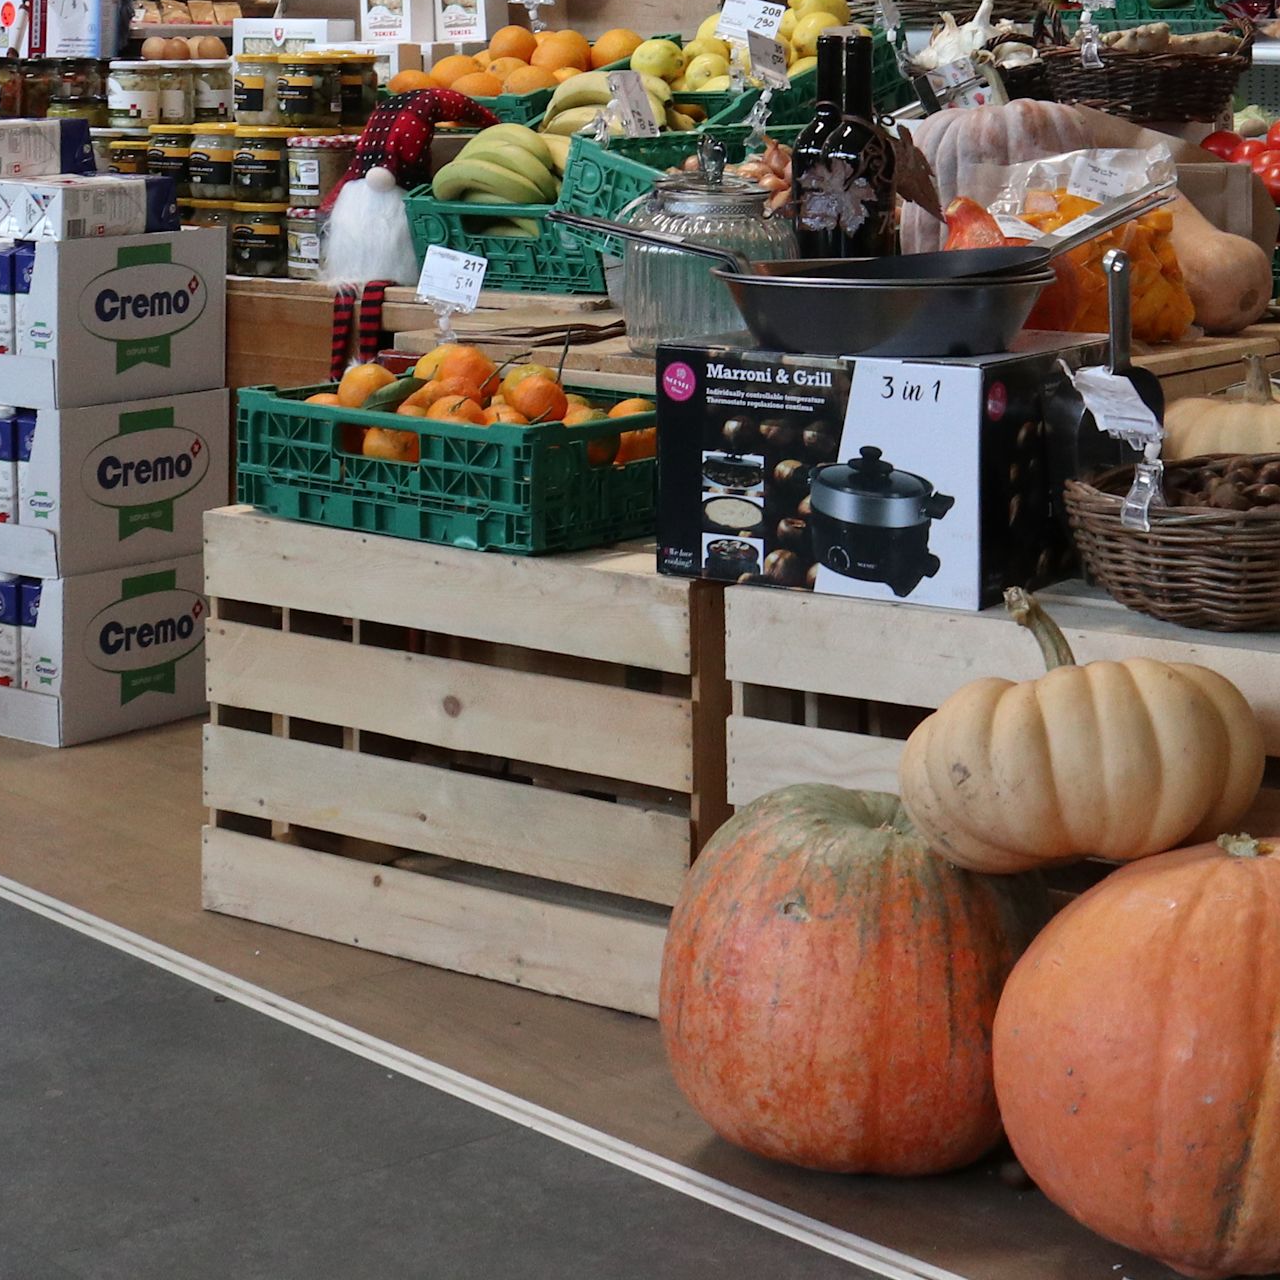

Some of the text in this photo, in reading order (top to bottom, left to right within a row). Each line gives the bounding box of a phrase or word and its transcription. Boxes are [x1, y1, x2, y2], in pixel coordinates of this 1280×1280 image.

[762, 6, 782, 17] 208
[463, 259, 484, 273] 217
[95, 288, 190, 322] Cremo
[706, 363, 833, 387] Marroni & Grill
[706, 388, 825, 404] Individually controllable temperature
[881, 376, 942, 403] 3 in 1
[97, 453, 192, 490] Cremo
[99, 615, 194, 655] Cremo
